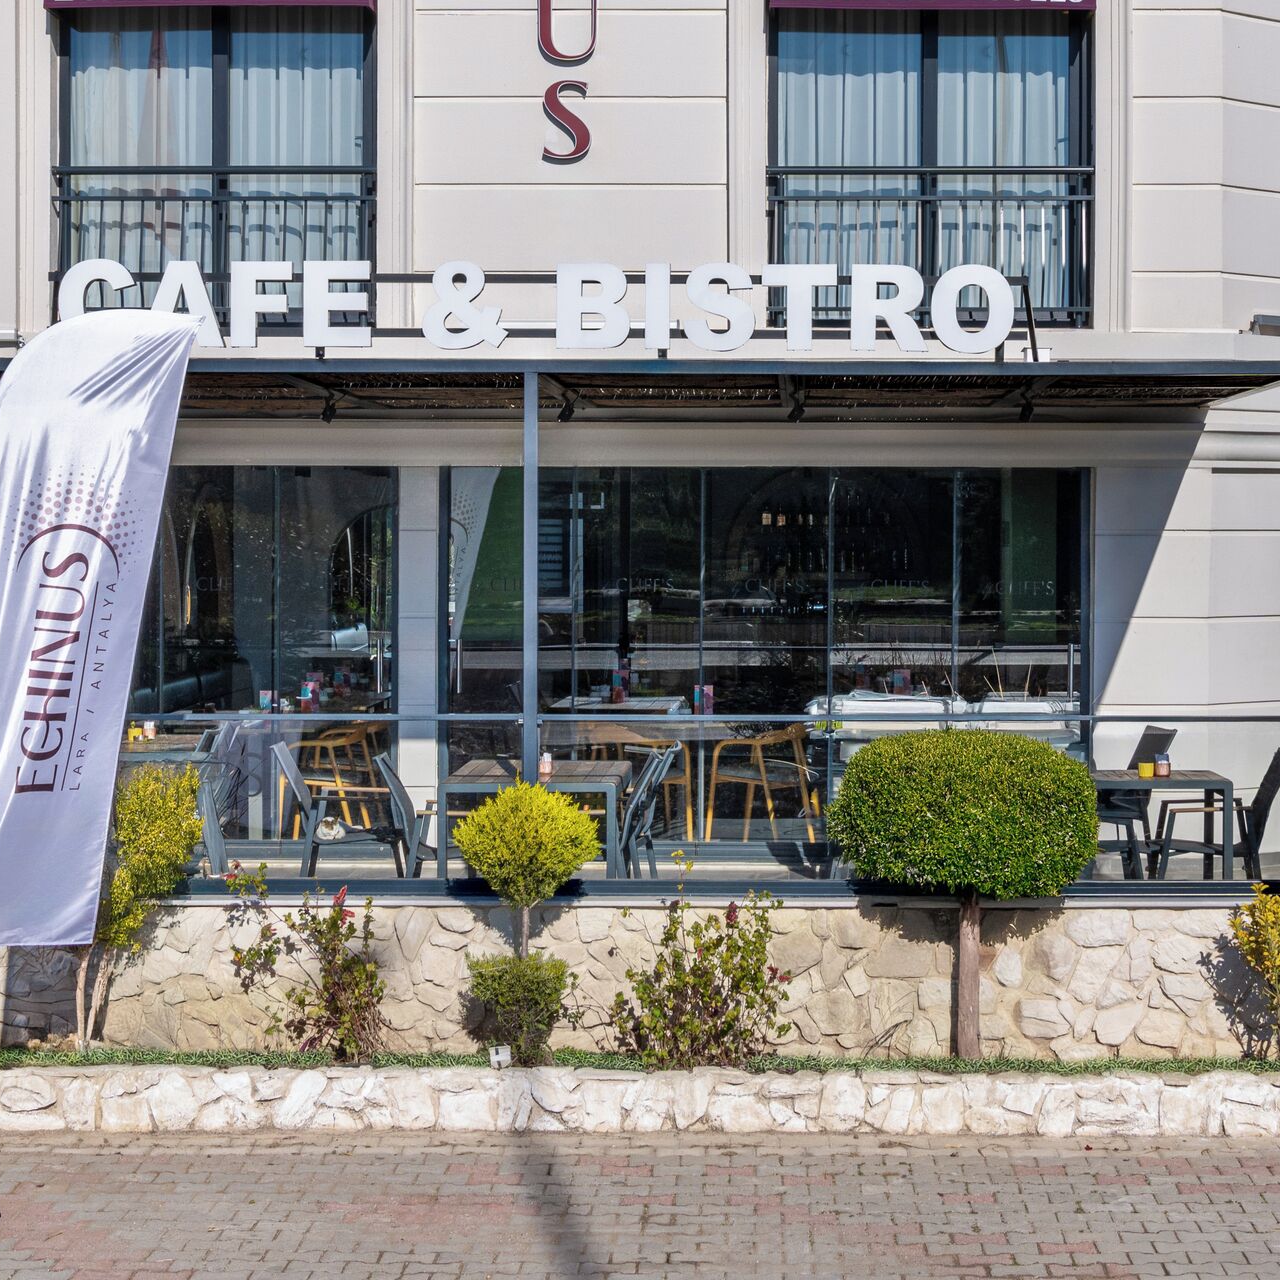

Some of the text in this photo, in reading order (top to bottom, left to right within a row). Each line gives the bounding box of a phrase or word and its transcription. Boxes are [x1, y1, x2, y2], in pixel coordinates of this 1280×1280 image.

[58, 258, 1015, 353] CAFE & BISTRO
[15, 552, 90, 794] ECHINUS
[69, 732, 89, 791] LARA
[91, 582, 117, 690] ANTALYA
